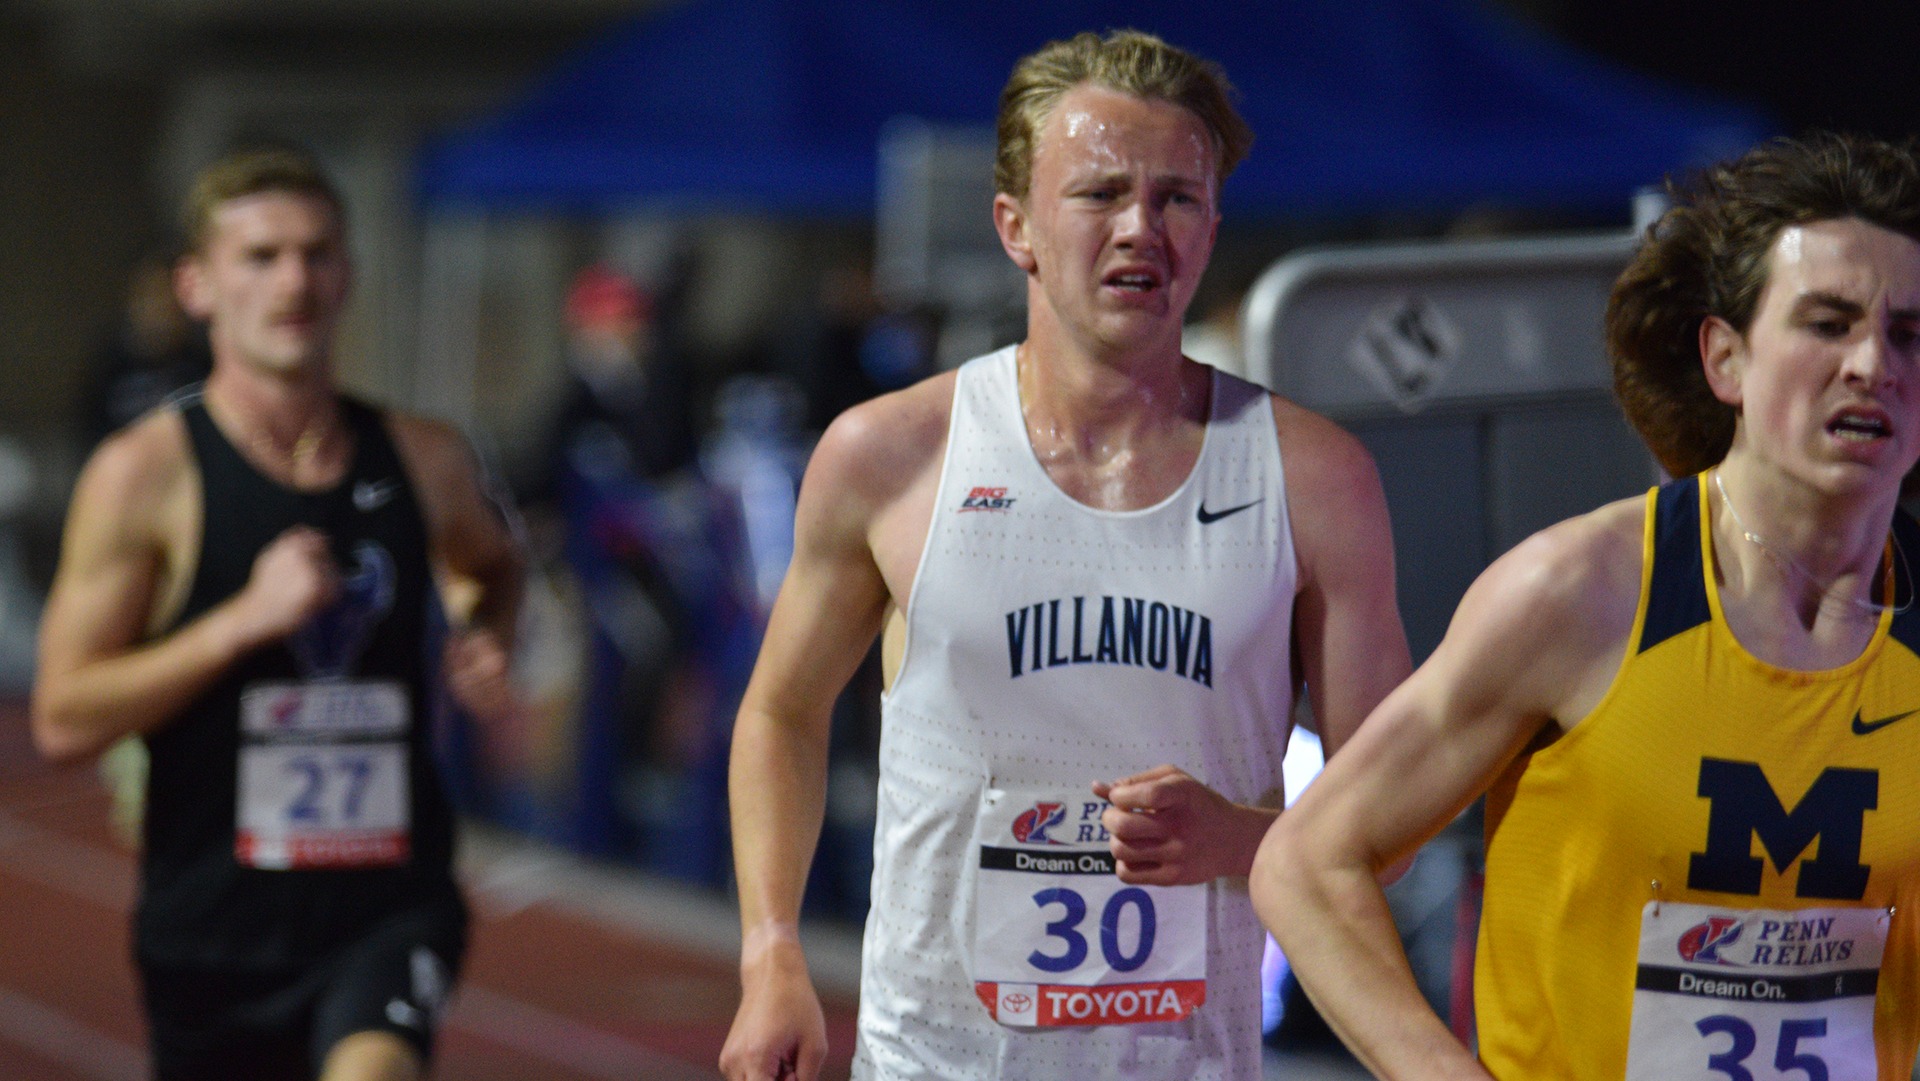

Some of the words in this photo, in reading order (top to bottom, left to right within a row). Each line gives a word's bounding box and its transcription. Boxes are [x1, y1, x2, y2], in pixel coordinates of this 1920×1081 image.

[963, 498, 1017, 508] EAST
[969, 487, 1007, 498] BIG
[1005, 595, 1214, 689] VILLANOVA
[285, 757, 370, 821] 27
[1687, 756, 1879, 901] M
[1015, 852, 1076, 872] Dream
[1078, 855, 1110, 873] On.
[1026, 887, 1156, 973] 30
[1758, 917, 1834, 941] PENN
[1751, 940, 1854, 966] RELAYS
[1678, 973, 1747, 998] Dream
[1750, 979, 1787, 1000] On.
[1046, 989, 1182, 1018] TOYOTA
[1695, 1014, 1829, 1081] 35
